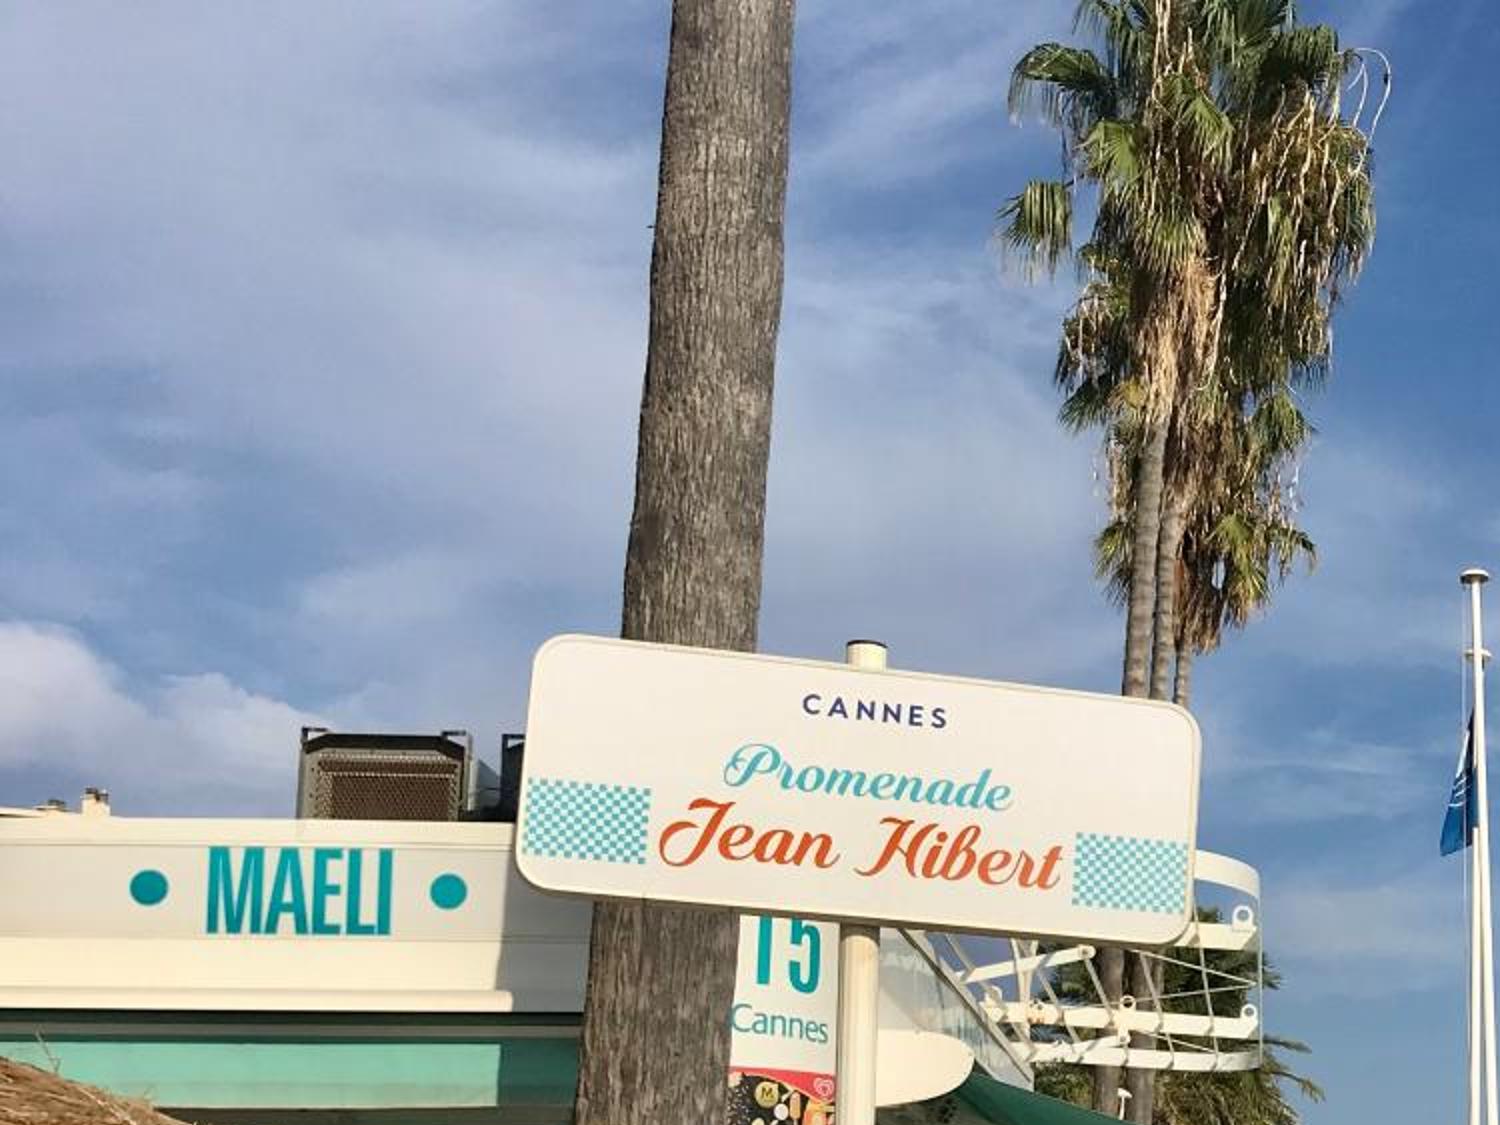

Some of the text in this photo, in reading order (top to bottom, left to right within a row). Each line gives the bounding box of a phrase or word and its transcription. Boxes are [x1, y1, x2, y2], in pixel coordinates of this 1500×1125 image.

[802, 693, 947, 729] CANNES
[723, 743, 1012, 811] Promenade
[658, 797, 1064, 891] Jean Hibert
[207, 846, 393, 936] MAELI
[729, 1003, 828, 1044] Cannes
